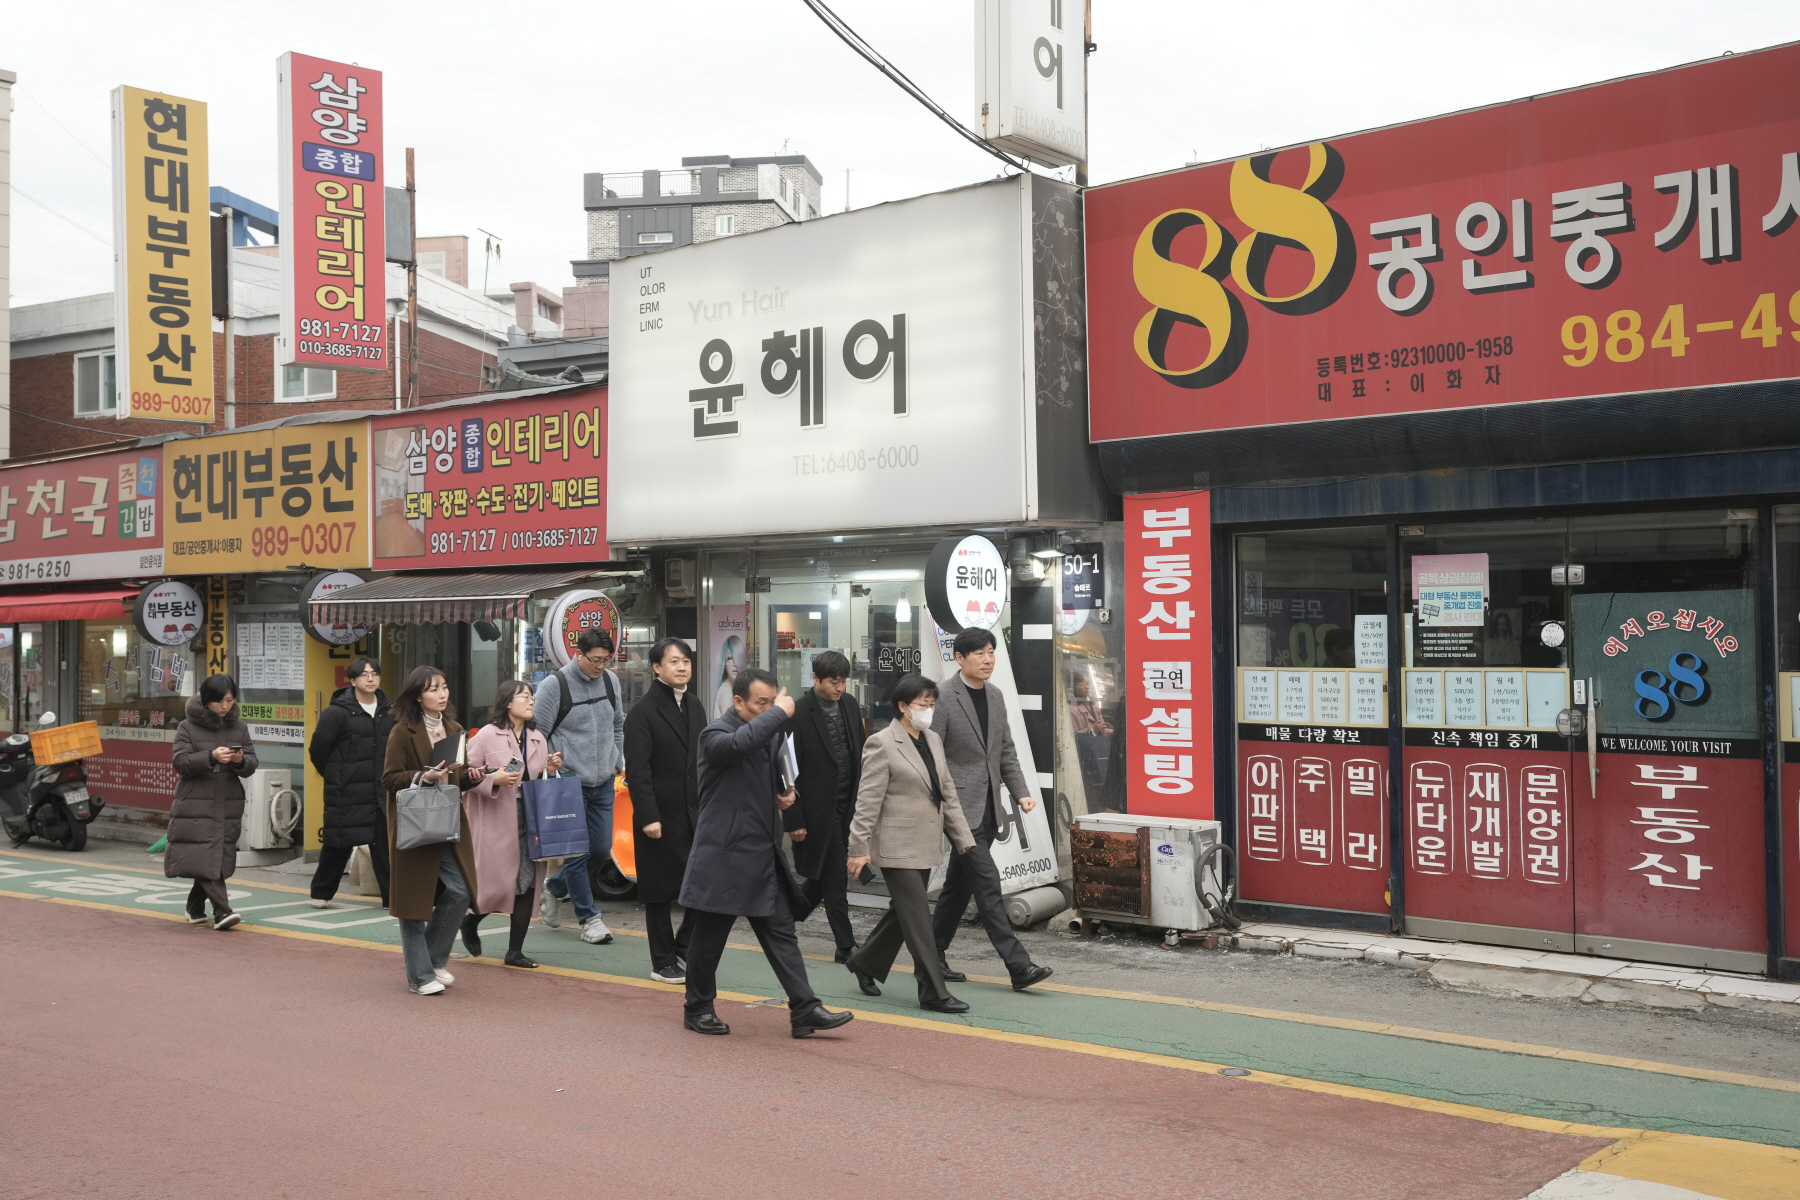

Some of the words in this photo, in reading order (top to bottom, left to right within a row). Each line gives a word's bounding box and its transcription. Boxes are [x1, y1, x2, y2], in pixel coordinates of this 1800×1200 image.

[1033, 0, 1063, 110] 어
[309, 72, 366, 145] 삼양
[315, 148, 362, 174] 종합
[143, 98, 196, 387] 현대부동산
[314, 181, 365, 320] 인테리어
[1133, 142, 1357, 388] 88
[687, 299, 732, 325] Yun
[741, 286, 790, 316] Hair
[299, 318, 381, 342] 981-7127
[299, 340, 382, 360] 010-3685-7127
[1316, 335, 1514, 376] 등록번호:92310000-1958
[688, 313, 908, 440] 윤헤어
[131, 391, 212, 416] 989-0307
[405, 425, 457, 476] 삼양
[464, 424, 481, 468] 종합
[486, 407, 601, 467] 인테리어
[792, 444, 919, 476] TEL:6408-6000
[173, 437, 357, 523] 현대부동산
[120, 503, 154, 534] 김밥
[251, 522, 357, 557] 989-0307
[430, 529, 496, 553] 981-7127
[511, 527, 598, 550] 010-3685-7127
[8, 560, 71, 580] 981-6250
[956, 565, 997, 591] 윤헤어
[1064, 553, 1100, 575] 50-1
[1138, 507, 1195, 640] 부동산
[1418, 572, 1484, 585] 골목상권침해!
[157, 600, 197, 618] 부동산
[1420, 592, 1435, 601] 대형
[1436, 592, 1458, 601] 부동산
[1460, 591, 1482, 601] 플랫폼
[1444, 601, 1466, 610] 중개업
[1468, 601, 1482, 610] 진출
[579, 610, 602, 628] 삼양
[1464, 612, 1482, 622] 반대
[1603, 608, 1739, 658] 어서오십시오
[1150, 668, 1184, 691] 금연
[1634, 652, 1711, 723] 88
[241, 705, 272, 718] 현대부동산
[1140, 661, 1194, 795] 설팅
[1265, 726, 1292, 741] 매물
[1298, 728, 1327, 743] 다량
[1332, 728, 1361, 743] 확보
[1431, 730, 1462, 747] 신속
[1468, 731, 1499, 748] 책임
[1506, 732, 1538, 749] 중개
[1602, 737, 1616, 750] WE
[1619, 738, 1667, 752] WELCOME
[1671, 740, 1699, 753] YOUR
[1702, 741, 1731, 754] VISIT
[1250, 761, 1279, 853] 아파트
[1299, 763, 1326, 859] 주택
[1347, 765, 1378, 863] 빌라
[1415, 768, 1447, 868] 뉴타운
[1468, 771, 1503, 873] 재개발
[1527, 772, 1561, 877] 분양권
[1628, 764, 1714, 891] 부동산
